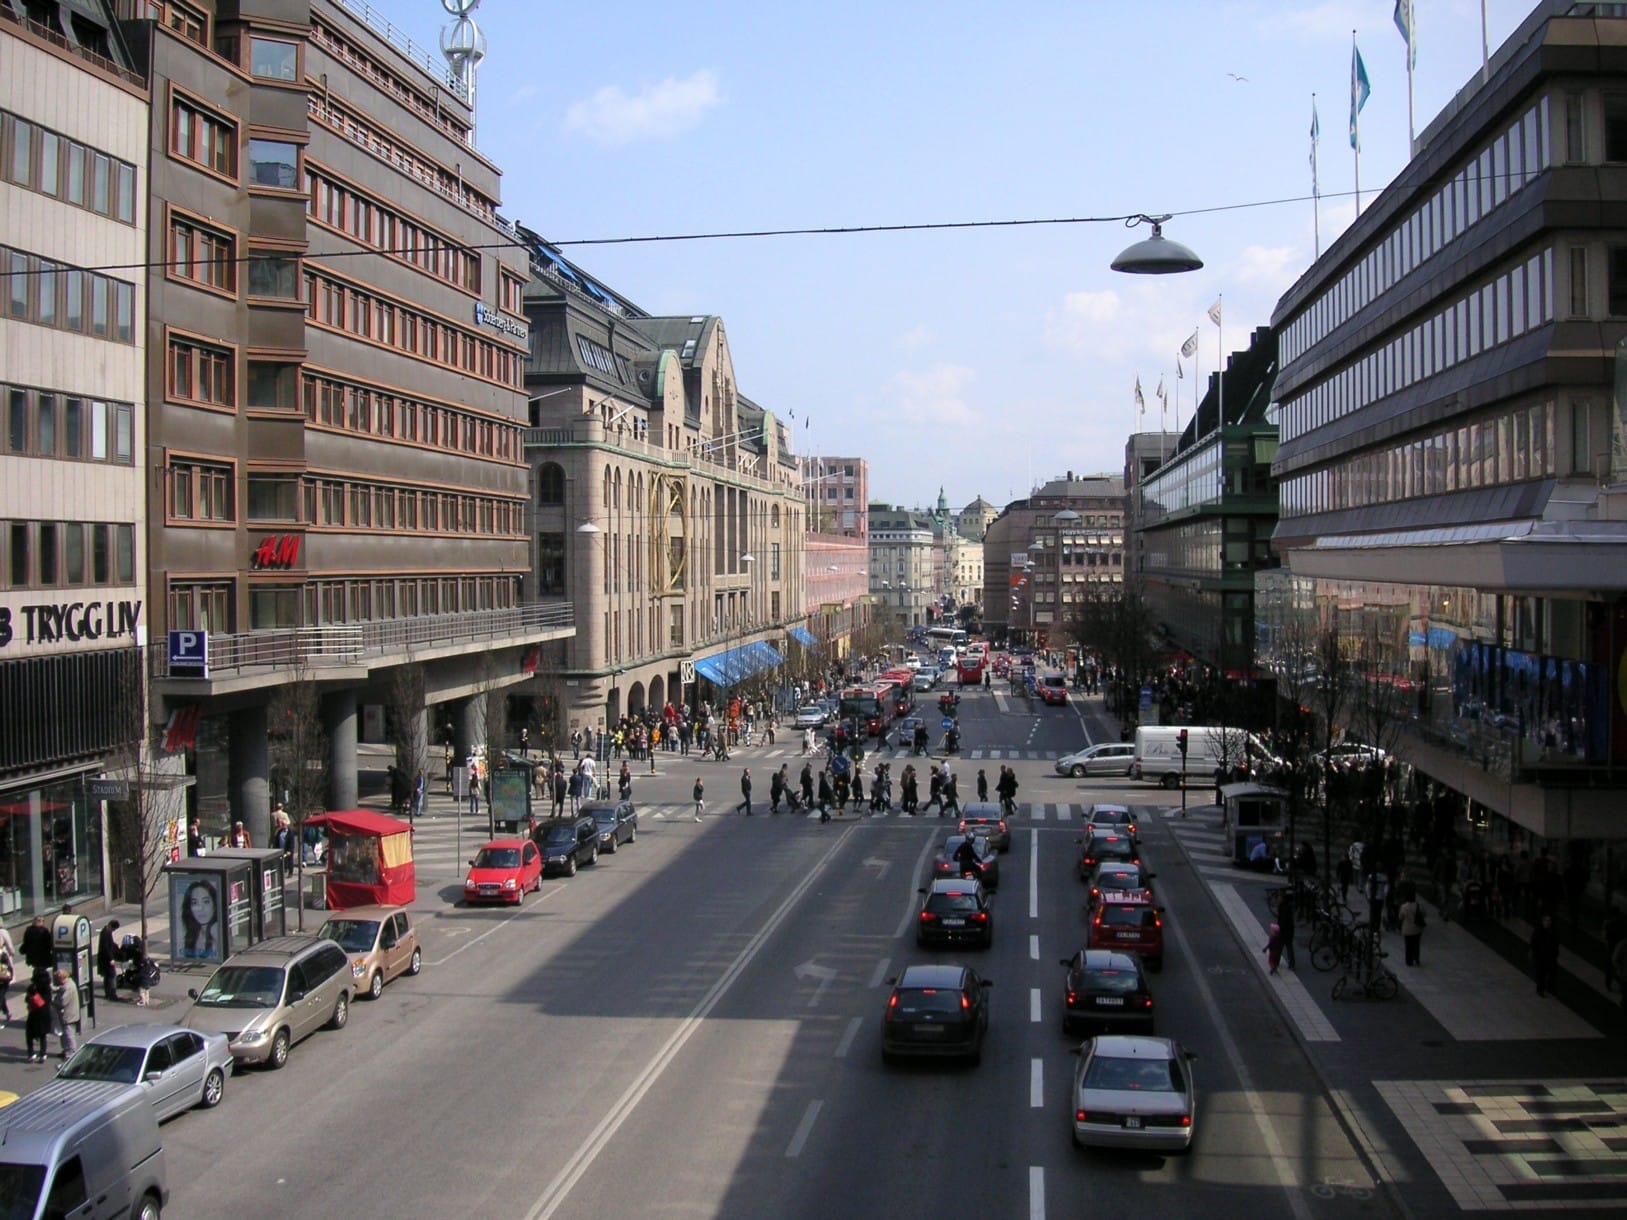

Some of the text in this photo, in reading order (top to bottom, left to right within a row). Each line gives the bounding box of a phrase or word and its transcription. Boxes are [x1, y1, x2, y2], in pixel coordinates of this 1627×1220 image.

[21, 602, 102, 645] TRYGG
[106, 600, 142, 639] LIV
[179, 633, 197, 655] P
[58, 926, 69, 939] P
[80, 923, 86, 936] P
